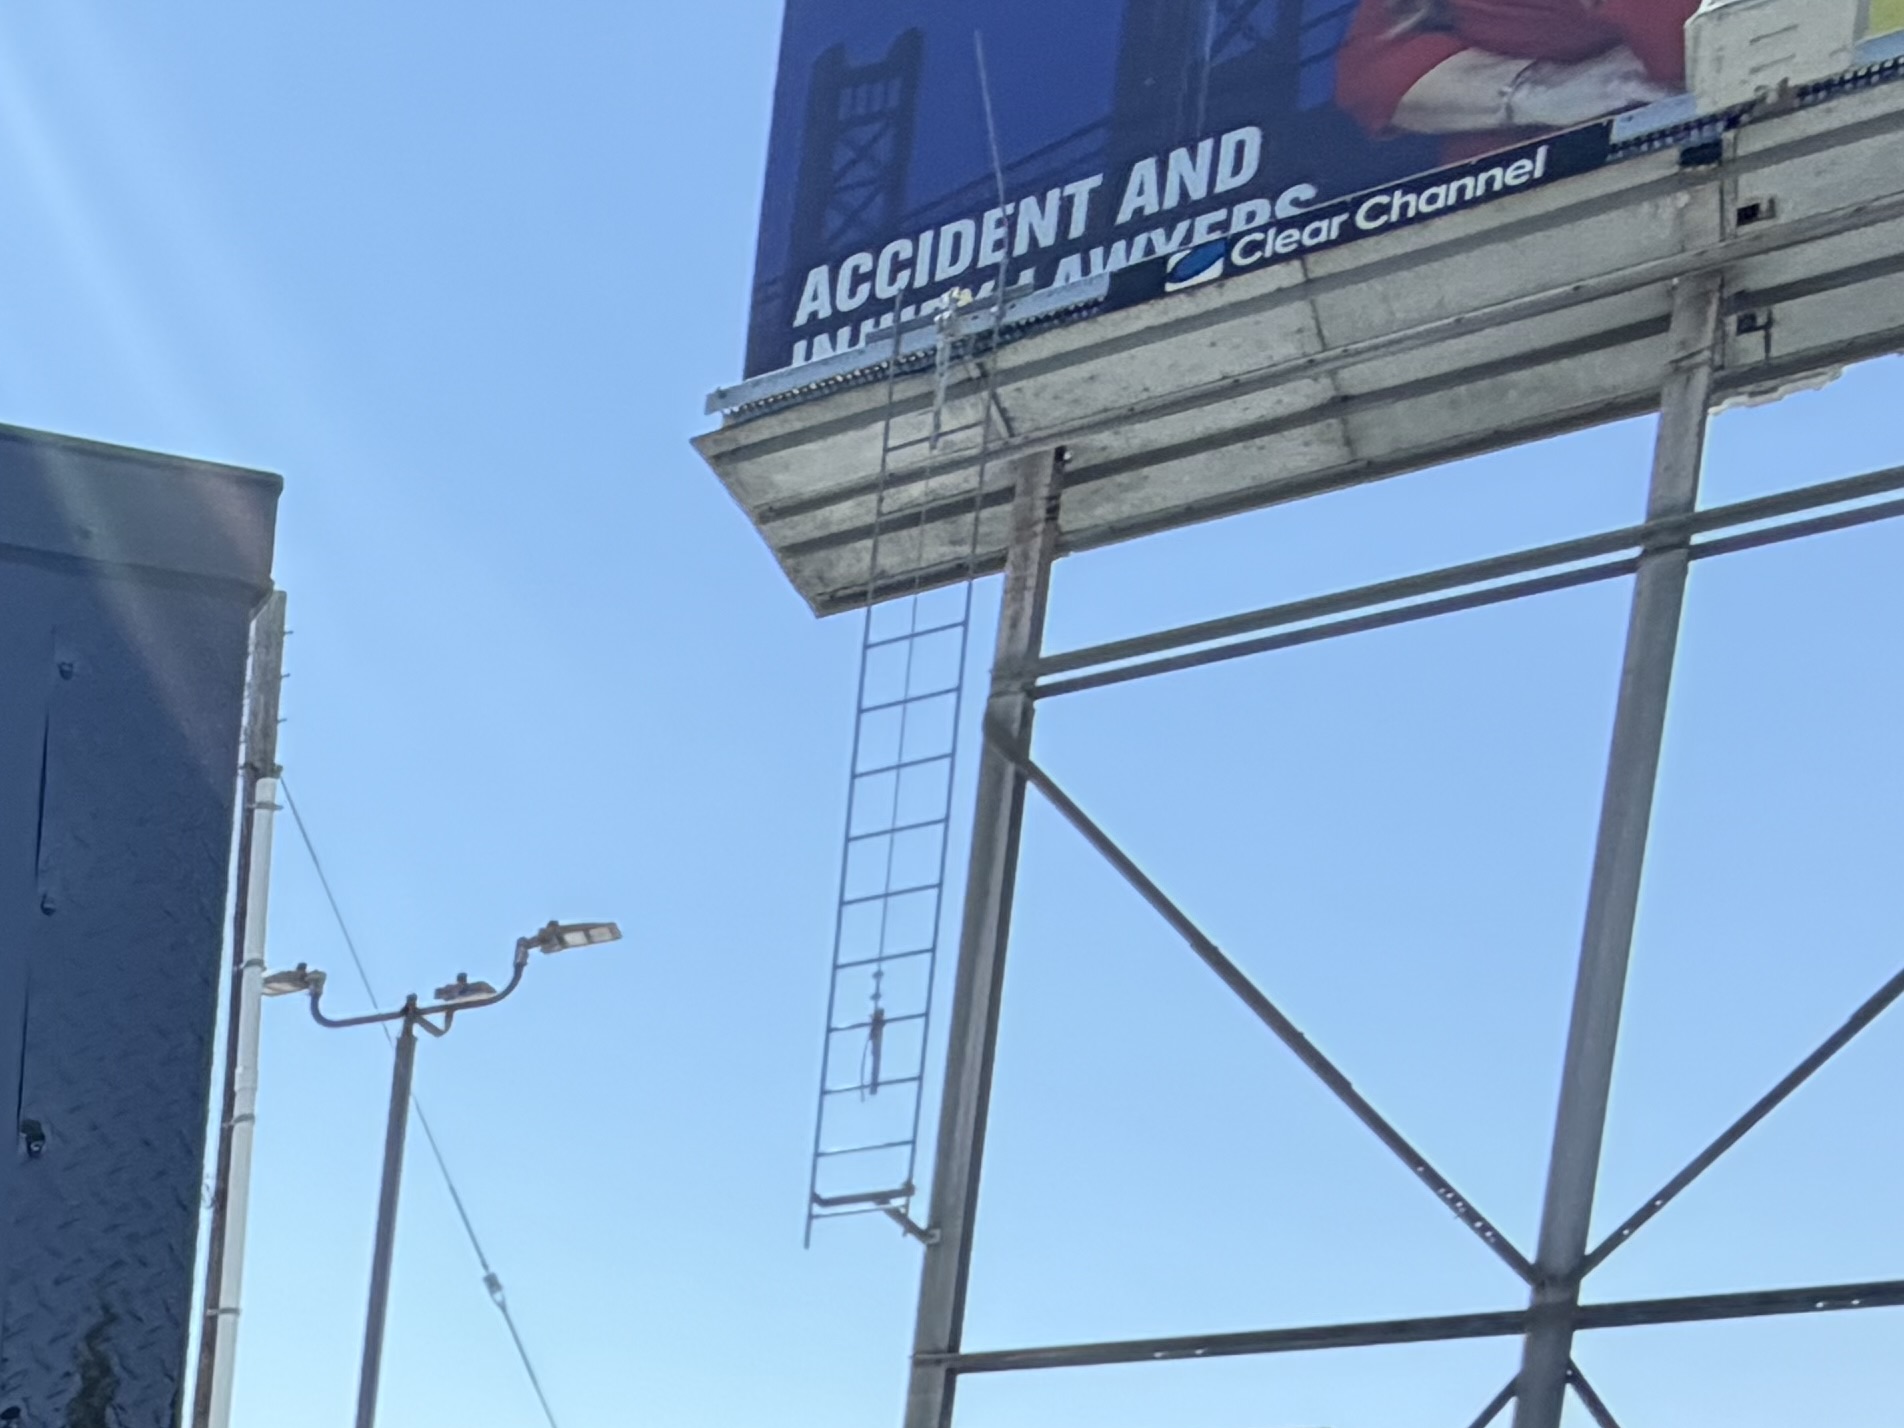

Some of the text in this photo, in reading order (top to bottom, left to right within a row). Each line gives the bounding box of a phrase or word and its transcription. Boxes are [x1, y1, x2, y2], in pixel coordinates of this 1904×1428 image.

[793, 174, 1103, 329] ACCIDENT
[1115, 126, 1263, 226] AND
[1231, 145, 1549, 267] Clear Channel
